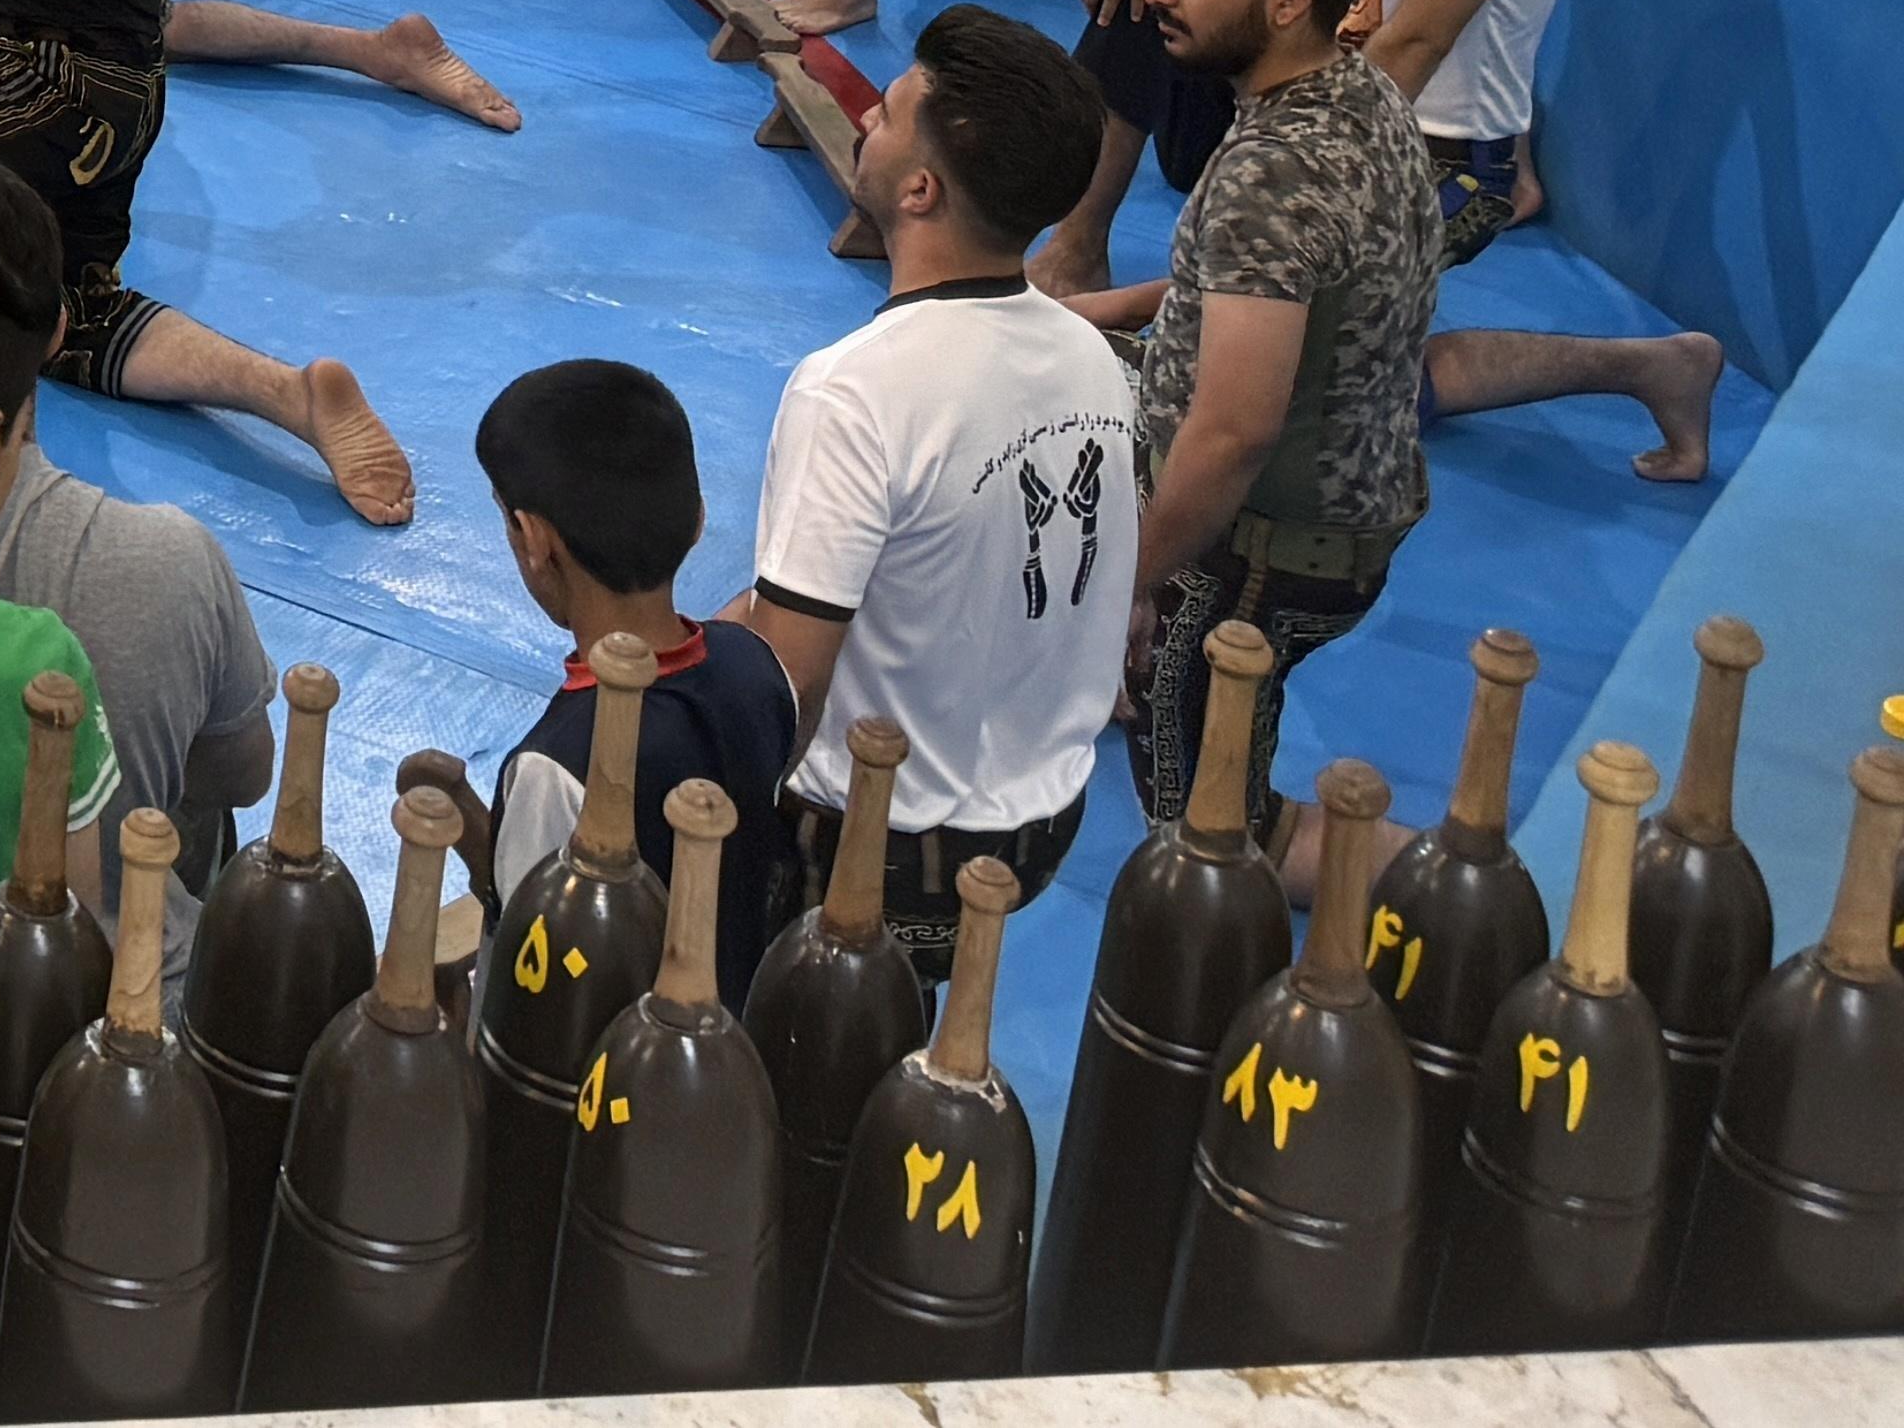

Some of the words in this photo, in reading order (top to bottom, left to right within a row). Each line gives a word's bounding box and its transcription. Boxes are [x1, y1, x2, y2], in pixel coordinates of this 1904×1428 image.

[514, 912, 589, 995] ۵۰
[1364, 904, 1423, 1001] ۴۱
[577, 1051, 632, 1133] ۵۰
[1221, 1041, 1318, 1151] ۸۳
[1518, 1032, 1589, 1133] ۴۱
[904, 1141, 982, 1241] ۲۸
